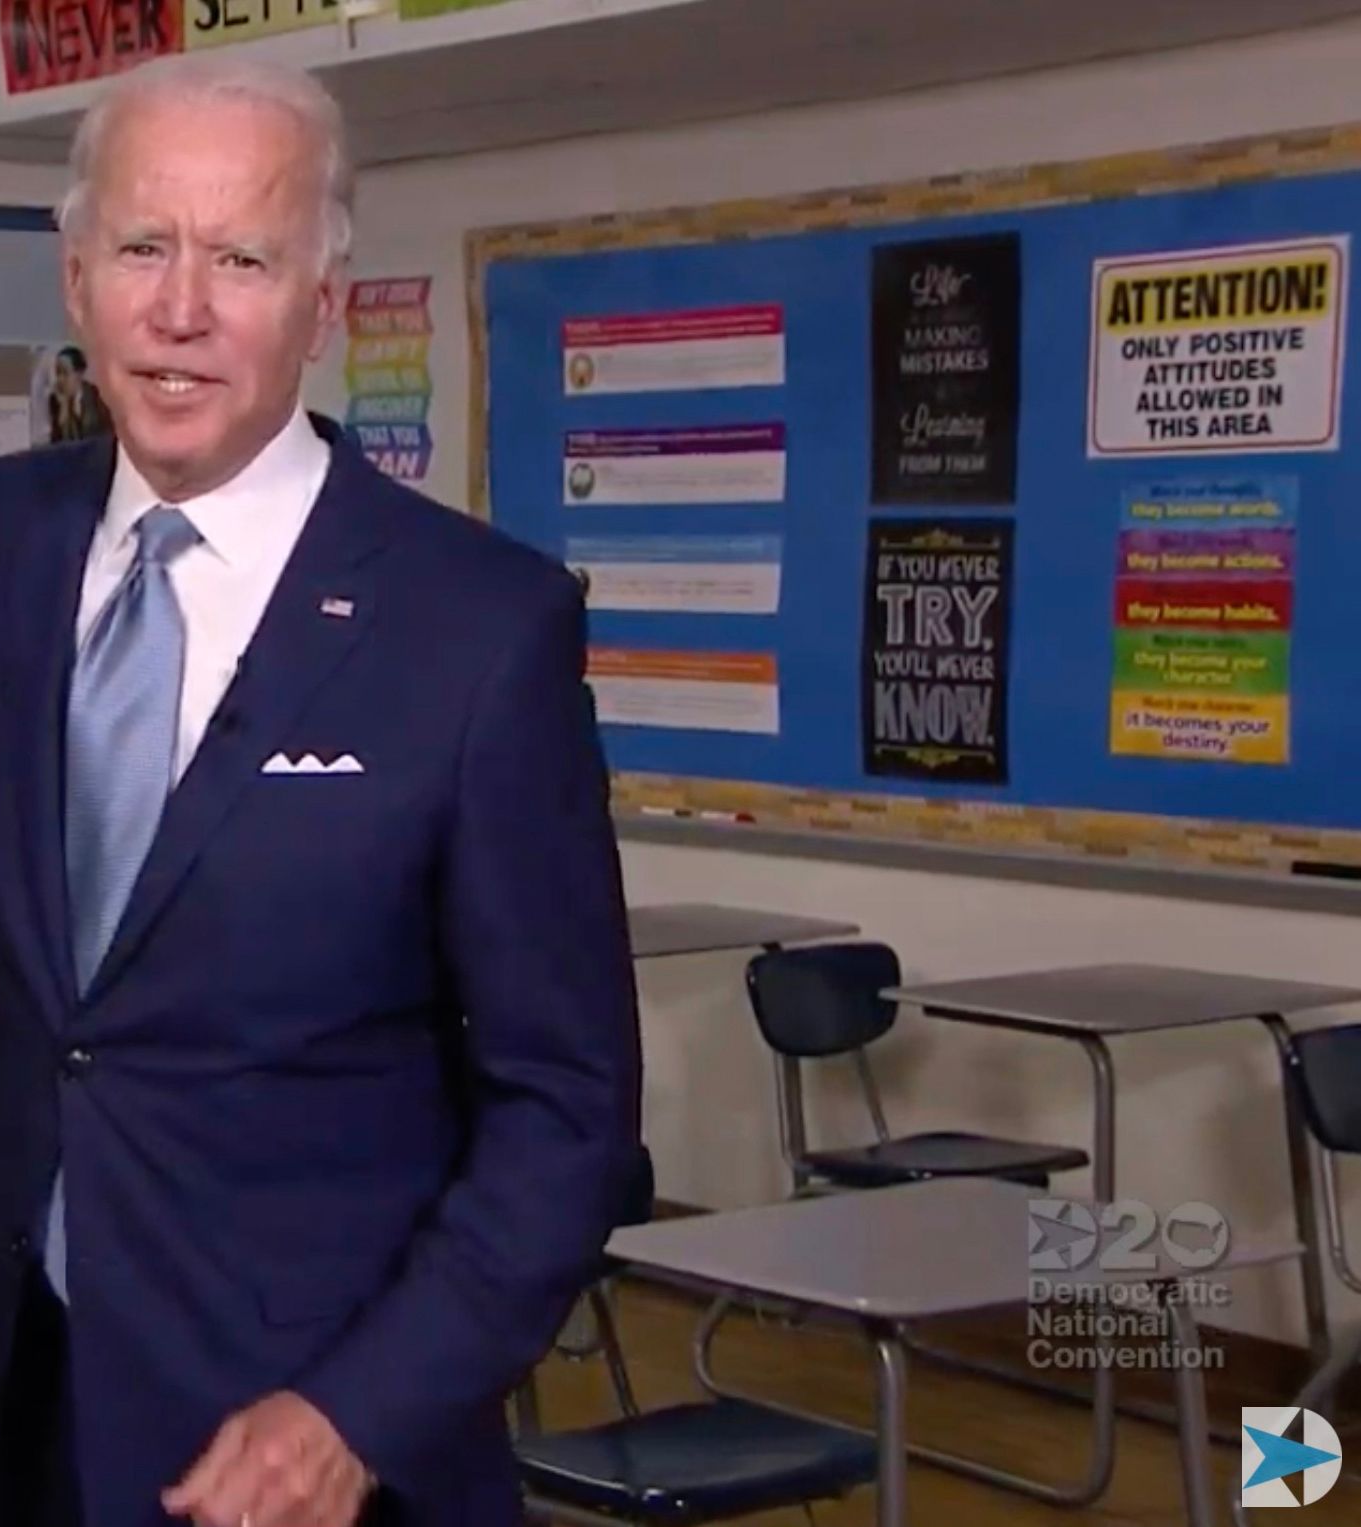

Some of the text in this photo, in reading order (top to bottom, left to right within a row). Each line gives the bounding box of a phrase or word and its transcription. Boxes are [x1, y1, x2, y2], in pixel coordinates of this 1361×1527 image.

[1108, 263, 1327, 327] ATTENTION!
[905, 325, 982, 347] MAKING
[1122, 327, 1305, 360] ONLY POSITIVE
[900, 349, 989, 374] MISTAKES
[1144, 357, 1276, 385] ATTITUDES
[1136, 384, 1283, 413] ALLOWED IN
[1146, 413, 1272, 440] THIS AREA
[877, 554, 1000, 581] IF YOU NEVER
[876, 583, 999, 652] TRY,
[874, 650, 995, 680] YOU'LL NEVER
[873, 680, 996, 746] KNOW.
[1143, 713, 1222, 731] becomes
[1228, 719, 1270, 736] your
